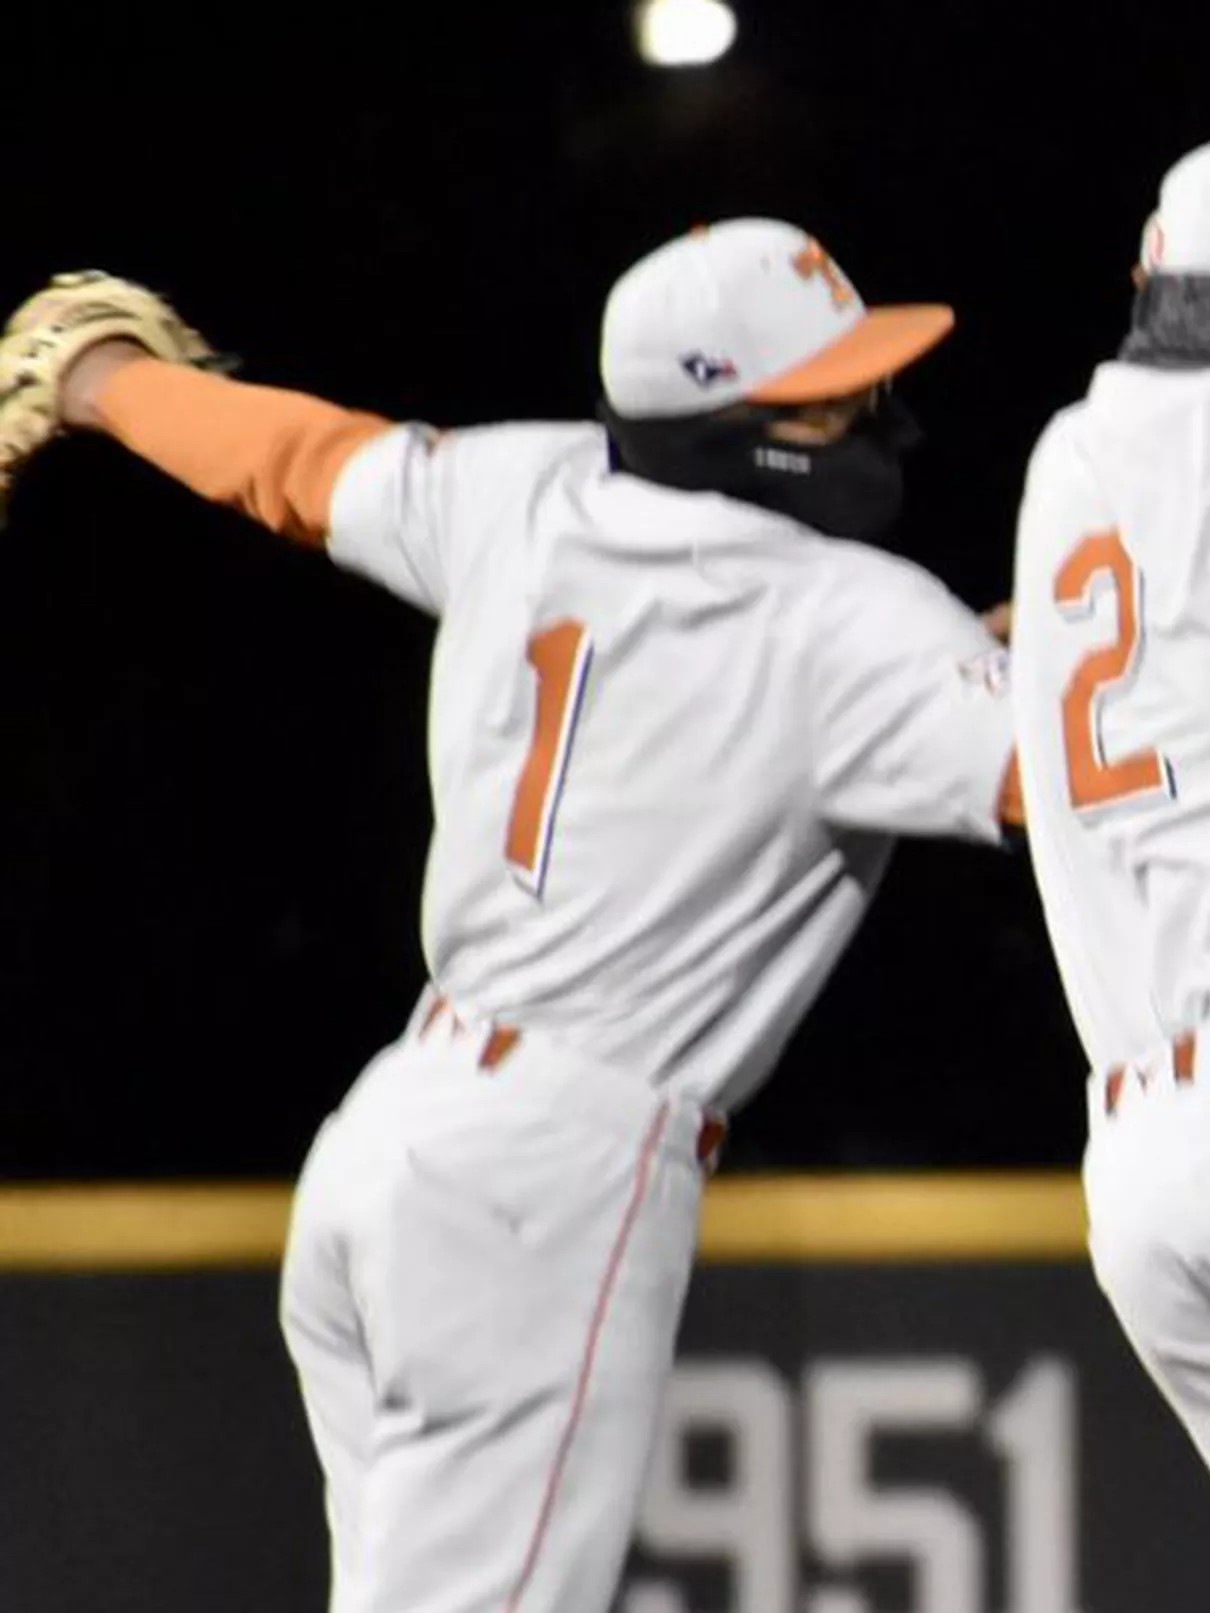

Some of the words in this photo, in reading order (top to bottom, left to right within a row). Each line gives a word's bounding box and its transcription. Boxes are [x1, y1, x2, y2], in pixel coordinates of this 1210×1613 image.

[504, 617, 594, 899] 1
[1053, 530, 1177, 822] 2
[622, 1354, 1078, 1613] 951
